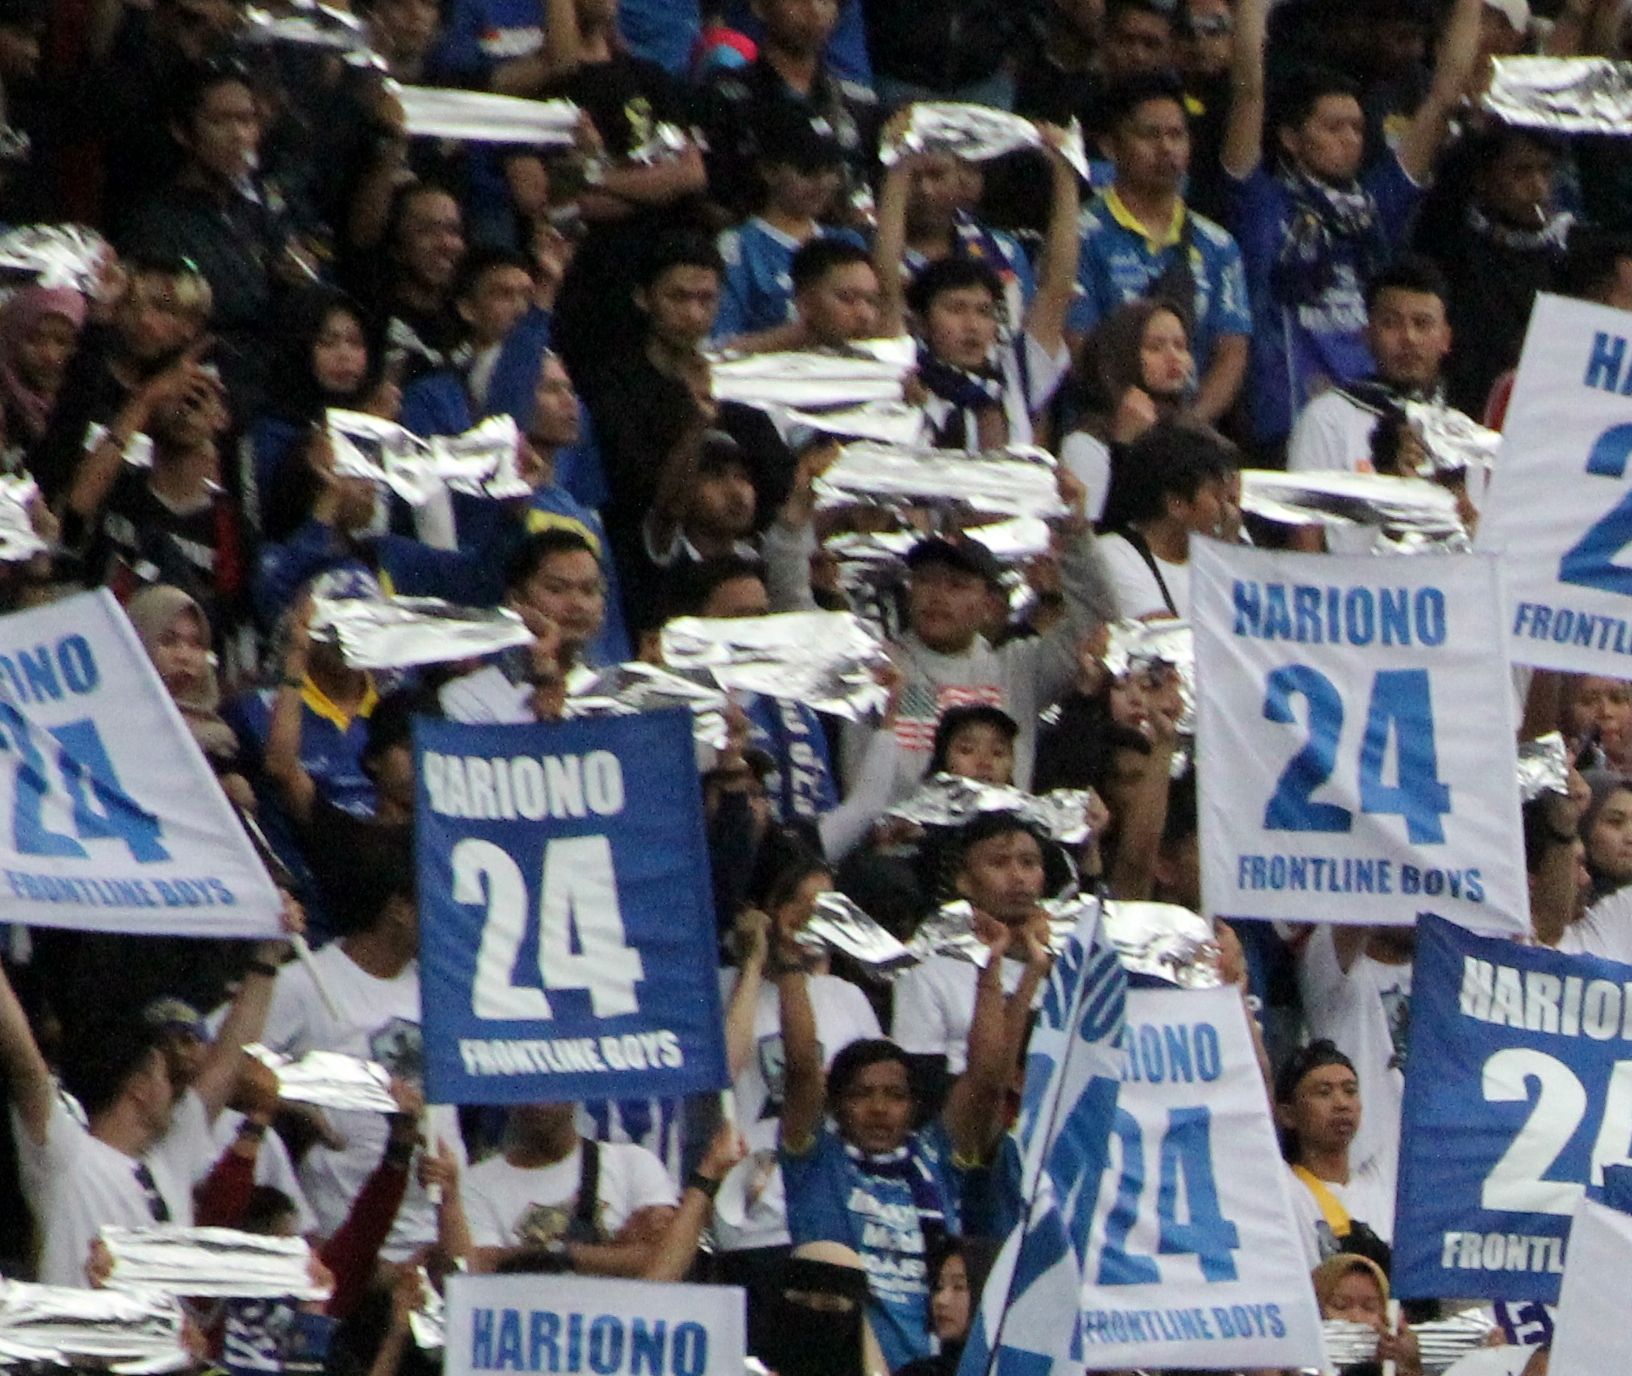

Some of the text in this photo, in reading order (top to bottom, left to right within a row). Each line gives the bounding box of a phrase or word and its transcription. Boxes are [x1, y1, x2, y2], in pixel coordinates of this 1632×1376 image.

[1233, 580, 1447, 648] HARIONO
[424, 749, 625, 820] HARIONO
[1264, 664, 1452, 845] 24
[154, 877, 238, 907] BOYS
[1237, 853, 1486, 902] FRONTLINE BOYS
[452, 835, 645, 1021] 24
[457, 1031, 684, 1077] FRONTLINE BOYS
[1099, 1106, 1240, 1287] 24
[1082, 1303, 1287, 1347] FRONTLINE BOYS
